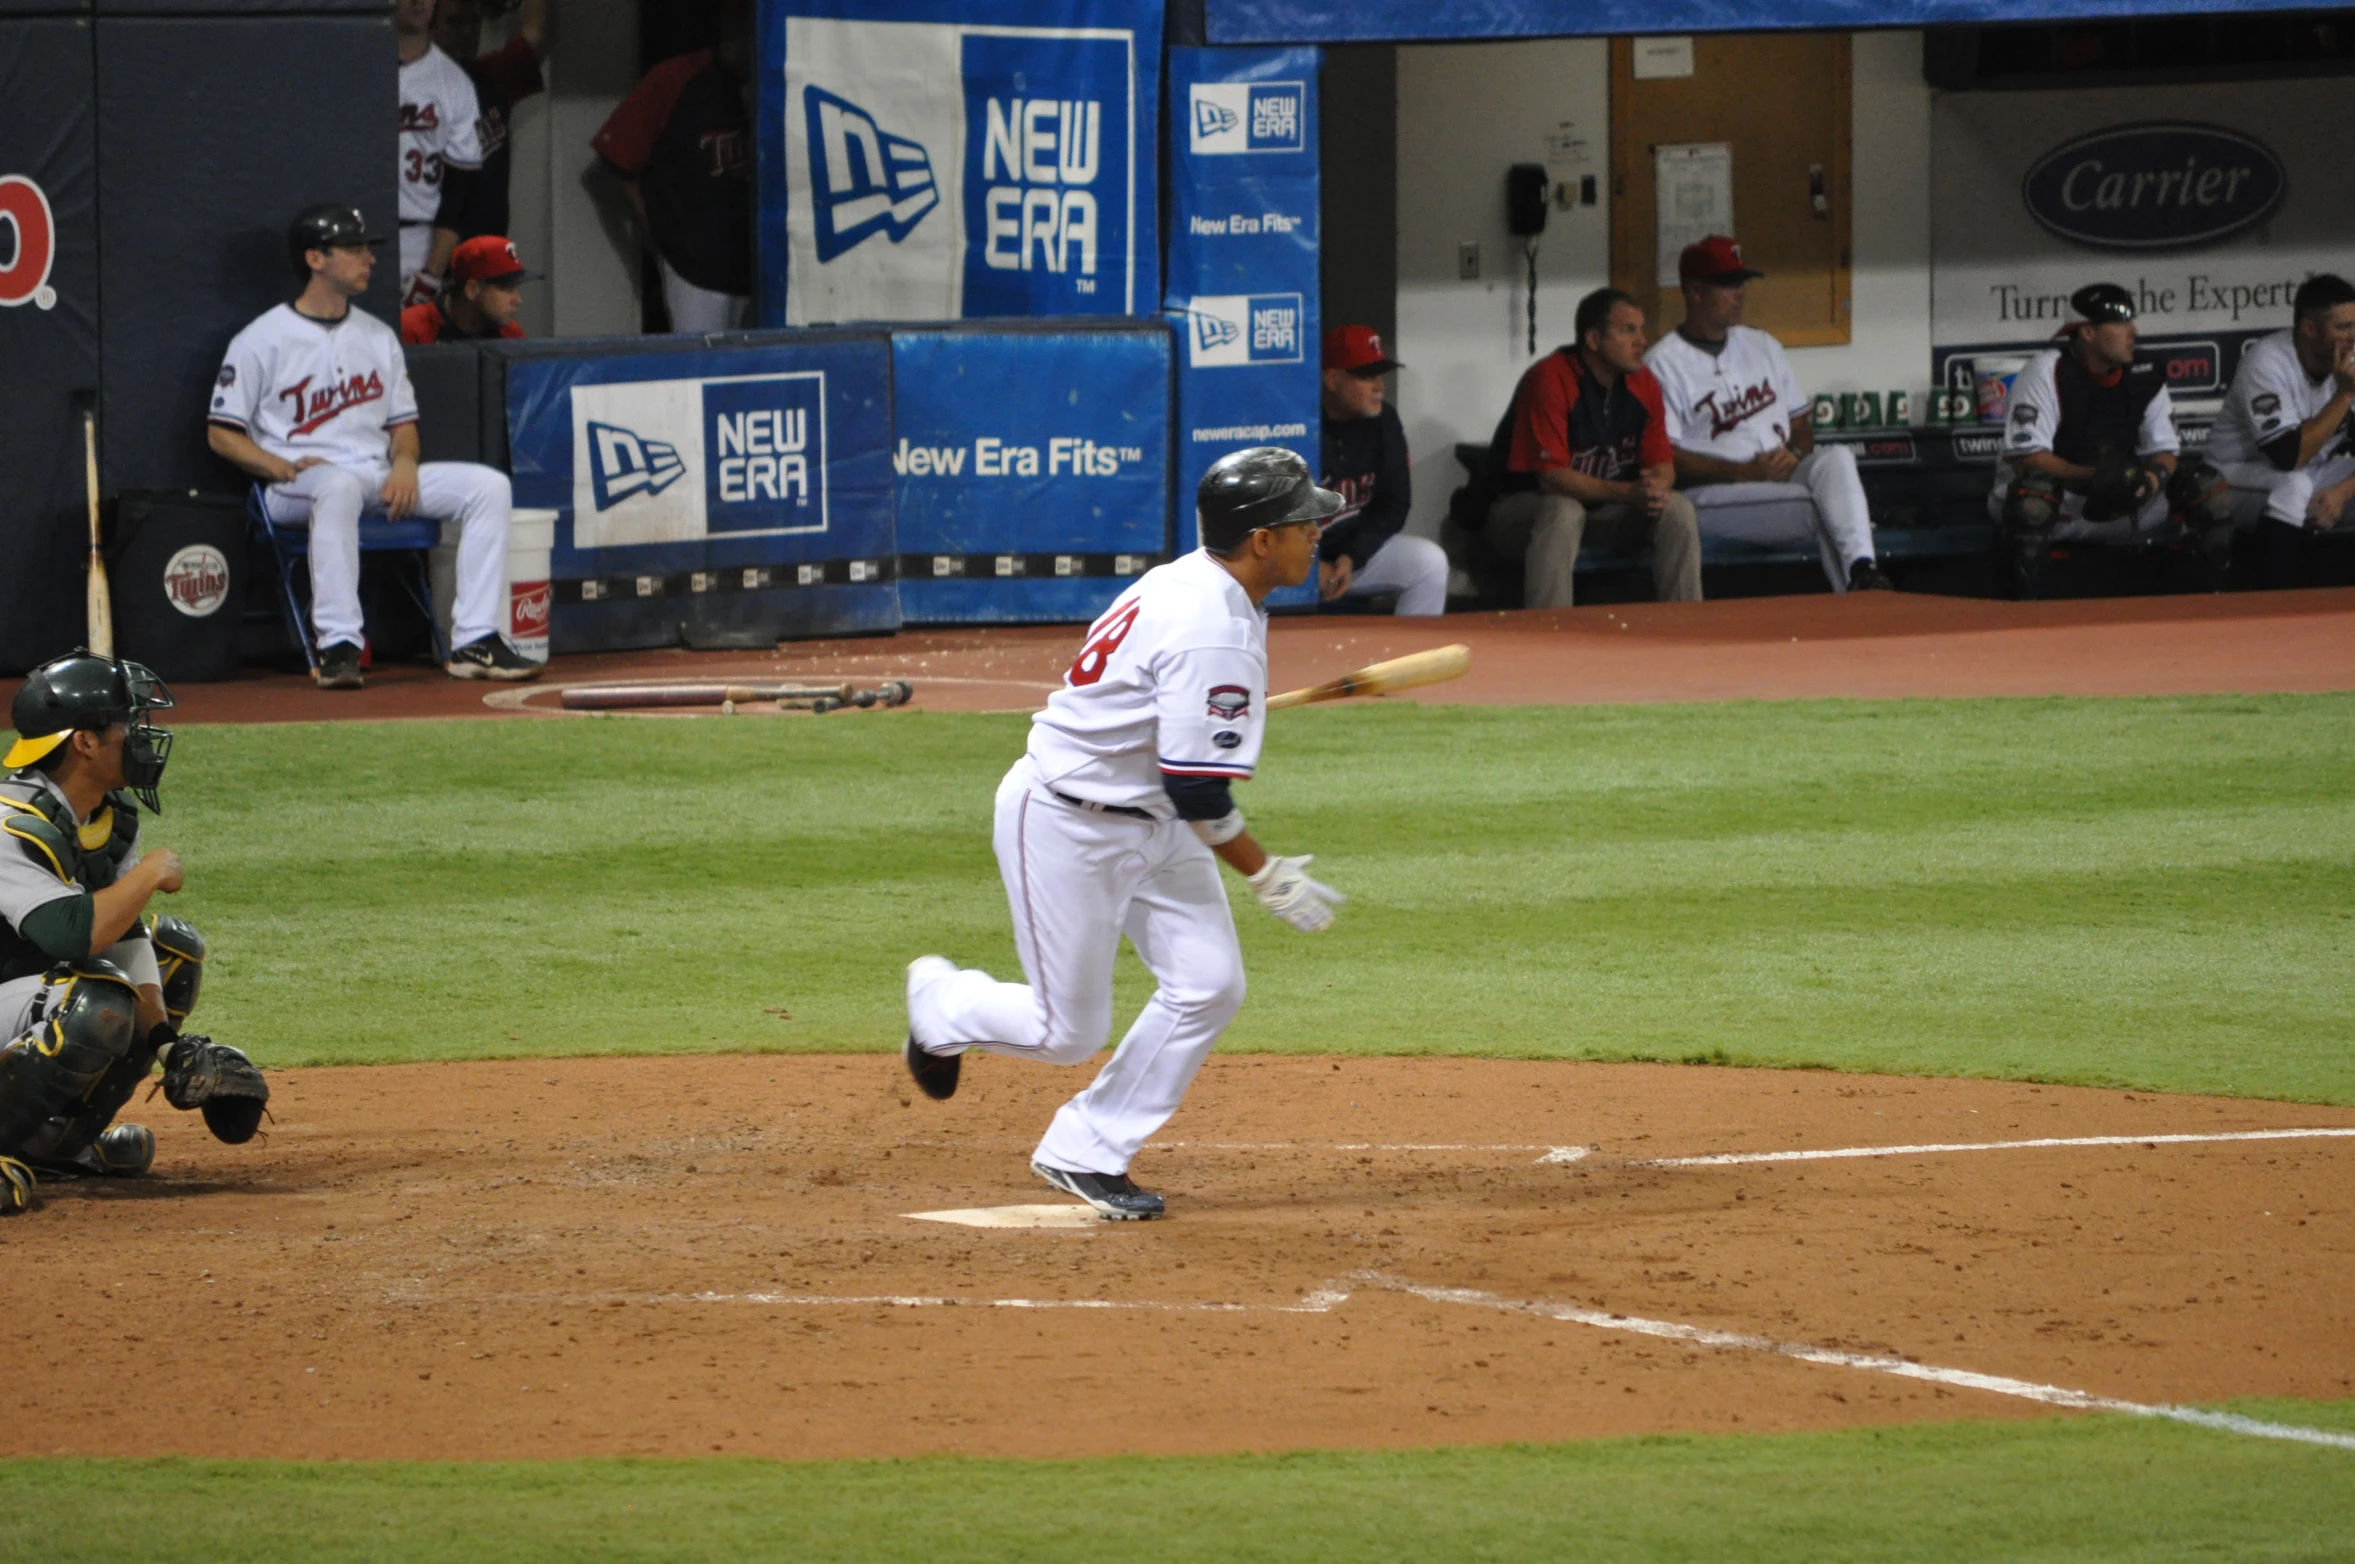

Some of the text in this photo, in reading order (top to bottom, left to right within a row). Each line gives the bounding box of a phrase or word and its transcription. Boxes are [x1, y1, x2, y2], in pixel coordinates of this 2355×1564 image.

[1253, 116, 1296, 137] ERA
[1254, 97, 1296, 118] NEW
[984, 97, 1100, 184] NEW
[405, 149, 444, 186] 33
[2061, 155, 2250, 212] Carrier
[985, 186, 1097, 275] ERA
[1190, 214, 1226, 235] New
[1230, 214, 1259, 234] Era
[1254, 309, 1295, 328] NEW
[1254, 328, 1295, 349] ERA
[279, 368, 384, 442] Twins
[1694, 377, 1777, 440] Twins
[717, 408, 806, 457] NEW
[1192, 423, 1307, 442] neweracap.com
[975, 438, 1038, 476] Era
[719, 454, 807, 501] ERA
